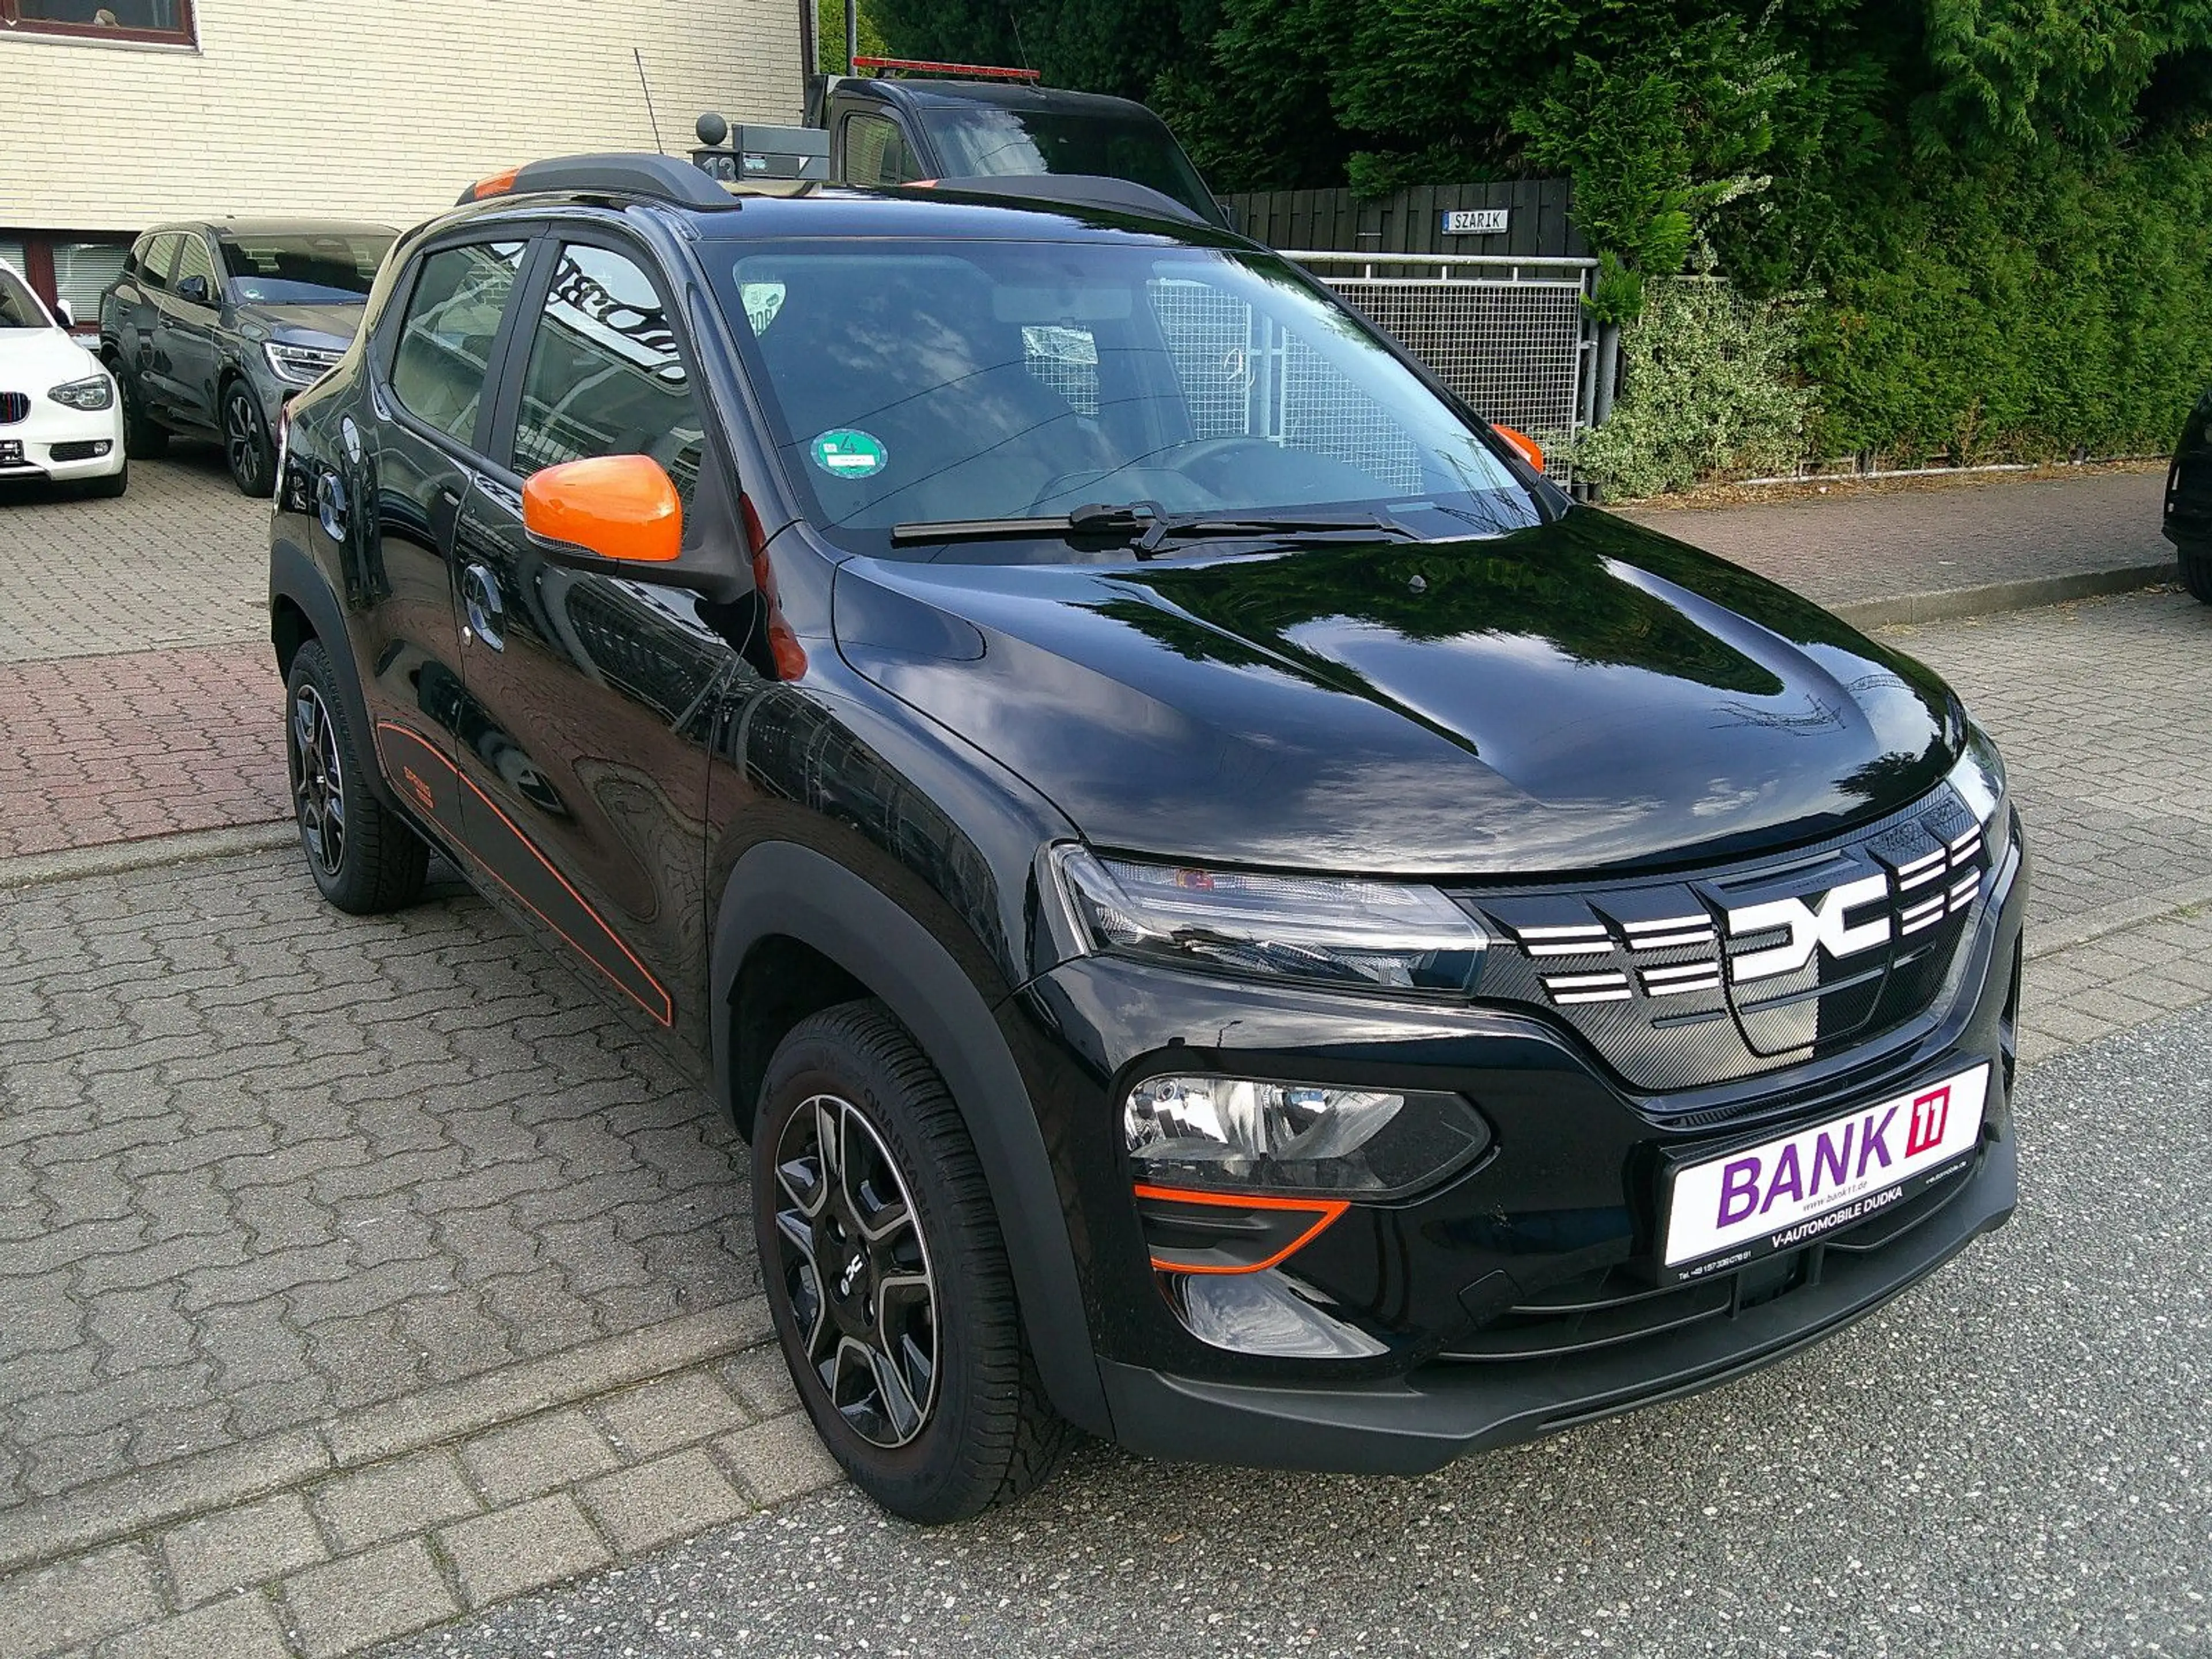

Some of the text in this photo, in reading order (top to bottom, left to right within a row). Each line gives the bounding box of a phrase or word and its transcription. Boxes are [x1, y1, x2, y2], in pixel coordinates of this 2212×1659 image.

[1455, 212, 1501, 229] SZARIK
[840, 435, 857, 453] 4
[1717, 1105, 1900, 1229] BANK
[1772, 1185, 1903, 1248] V-AUTOMOBILE DUDKA
